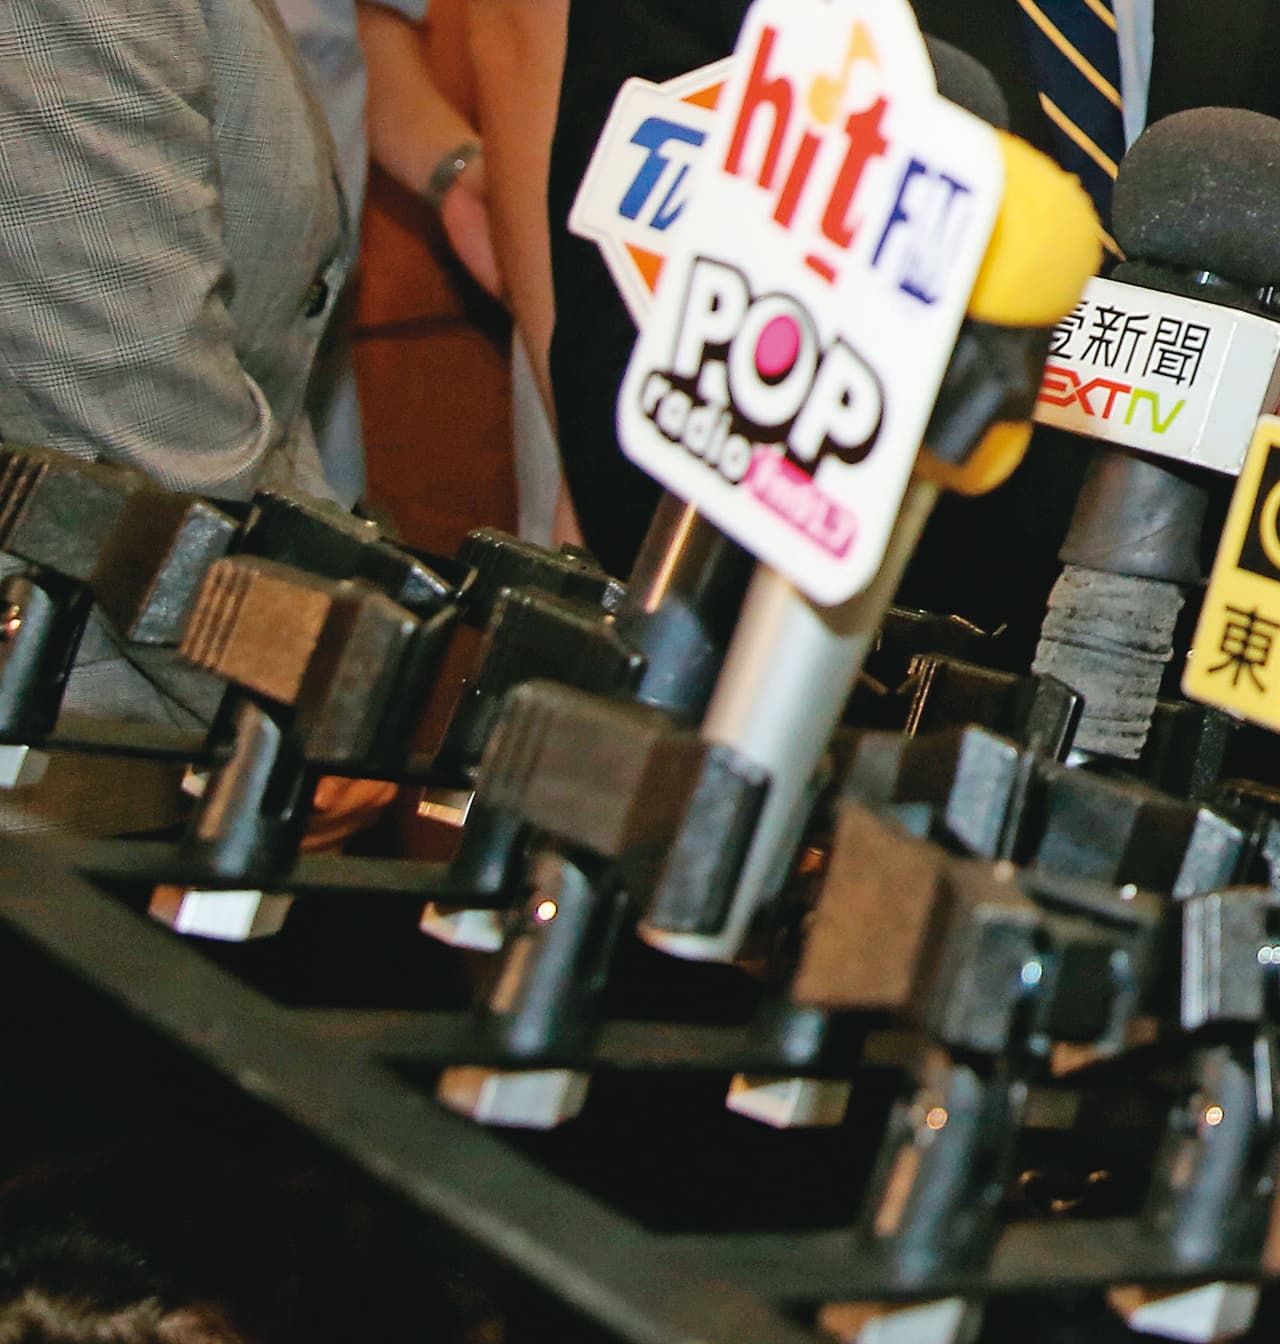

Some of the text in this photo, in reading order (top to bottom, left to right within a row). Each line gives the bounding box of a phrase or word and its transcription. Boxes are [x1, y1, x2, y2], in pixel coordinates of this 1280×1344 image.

[722, 24, 889, 251] hit
[640, 368, 752, 485] radio
[672, 254, 886, 466] POP
